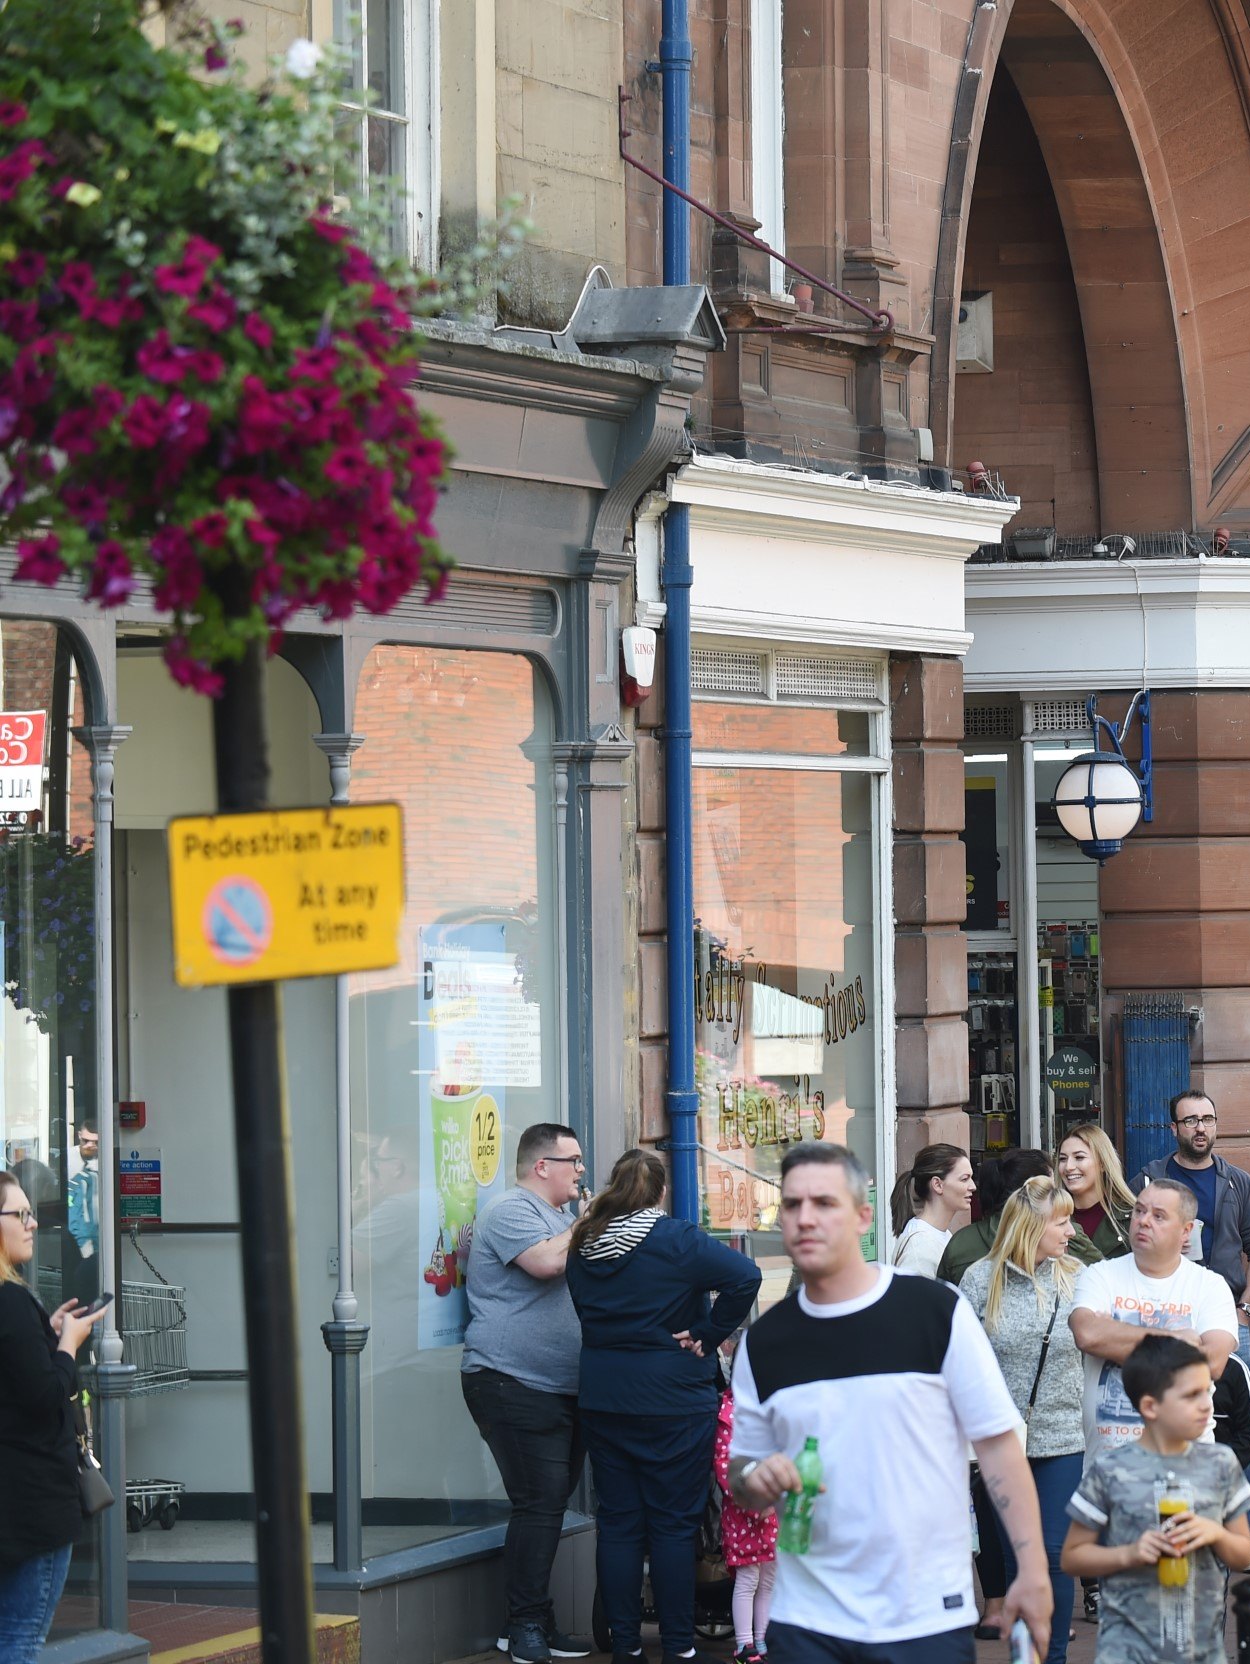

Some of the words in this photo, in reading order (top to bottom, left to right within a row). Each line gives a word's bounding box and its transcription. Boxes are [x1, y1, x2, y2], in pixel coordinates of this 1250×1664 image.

[183, 828, 321, 859] Pedestrian
[330, 823, 389, 849] Zone
[299, 883, 328, 908] At
[337, 882, 378, 909] any
[314, 917, 367, 944] time
[1062, 1054, 1079, 1063] We
[1046, 1067, 1065, 1078] buy
[1068, 1066, 1076, 1075] &
[1078, 1065, 1096, 1075] sell
[1052, 1079, 1090, 1089] Phones
[716, 1073, 826, 1151] Henri's
[475, 1111, 495, 1141] 1/2
[477, 1142, 495, 1160] price
[1160, 1302, 1192, 1316] TRIP
[1115, 1426, 1129, 1435] TO
